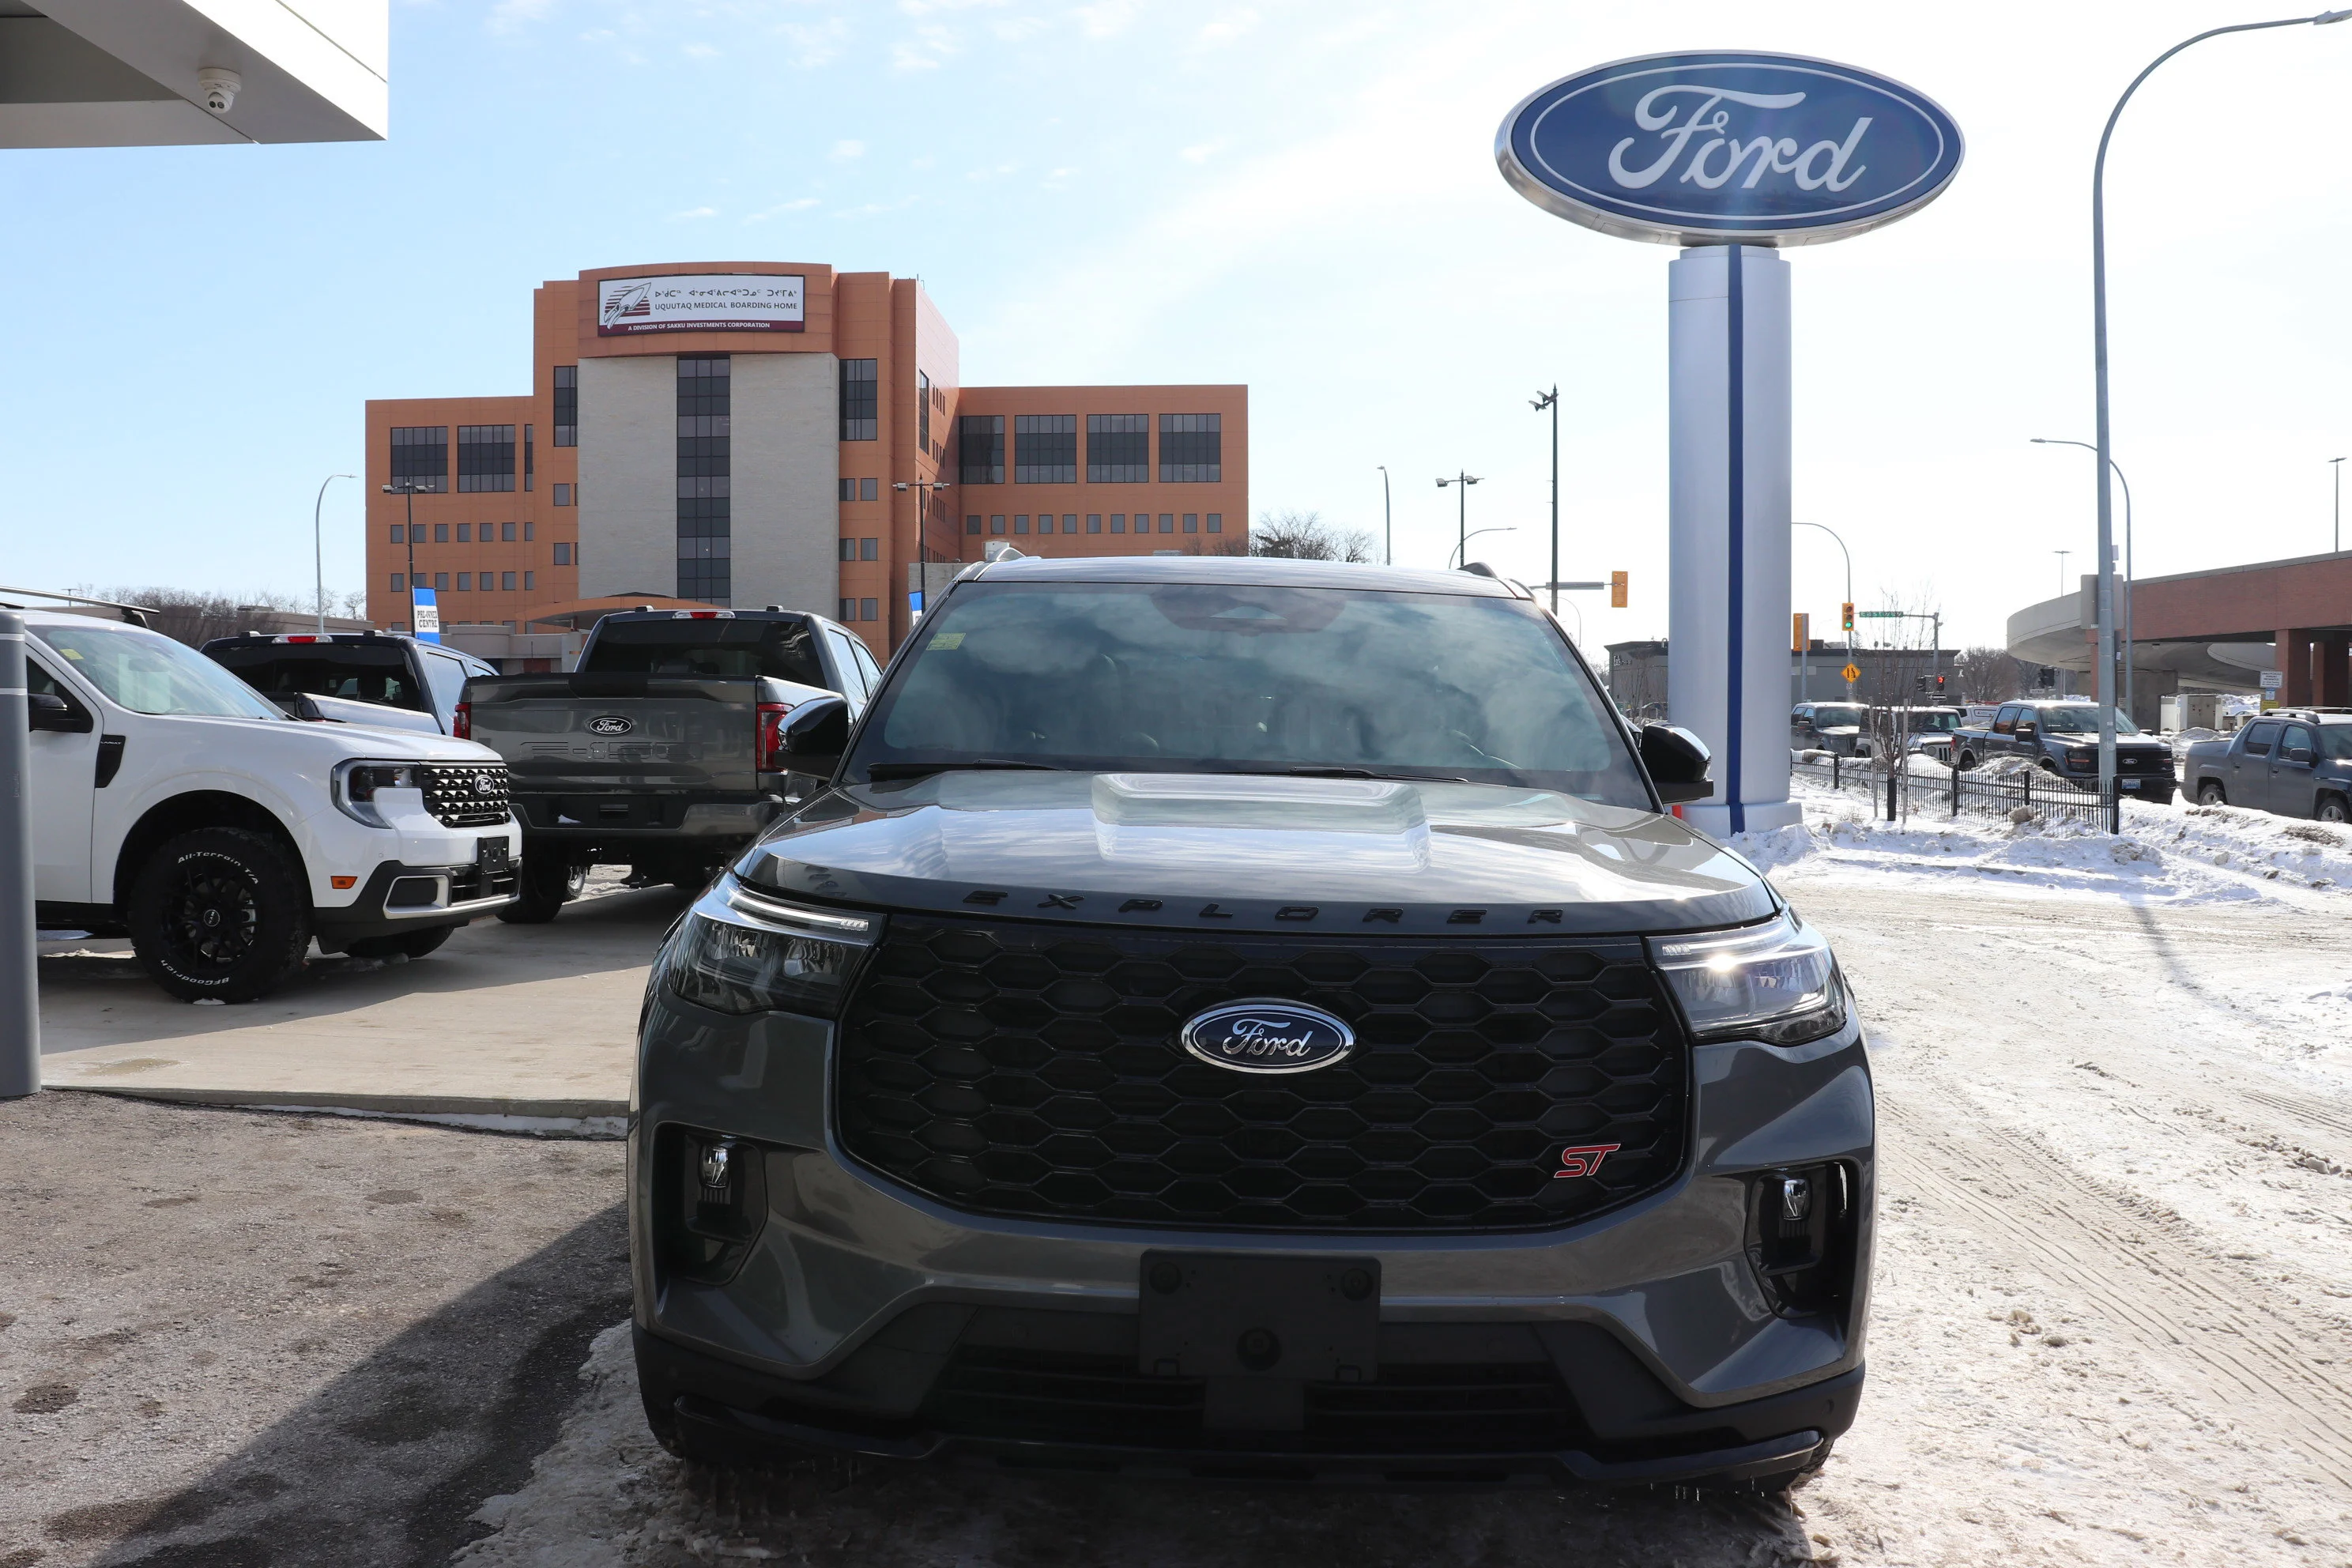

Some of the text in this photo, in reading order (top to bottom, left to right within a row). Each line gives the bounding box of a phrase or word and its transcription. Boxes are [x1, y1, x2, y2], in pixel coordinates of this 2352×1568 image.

[1608, 84, 1874, 192] Ford
[597, 719, 624, 732] Ford
[177, 851, 258, 884] All-Terrain T/A
[963, 890, 1563, 924] EXPLORER
[160, 959, 229, 986] BFGoodrich
[1223, 1018, 1314, 1057] Ford
[1553, 1143, 1622, 1178] ST
